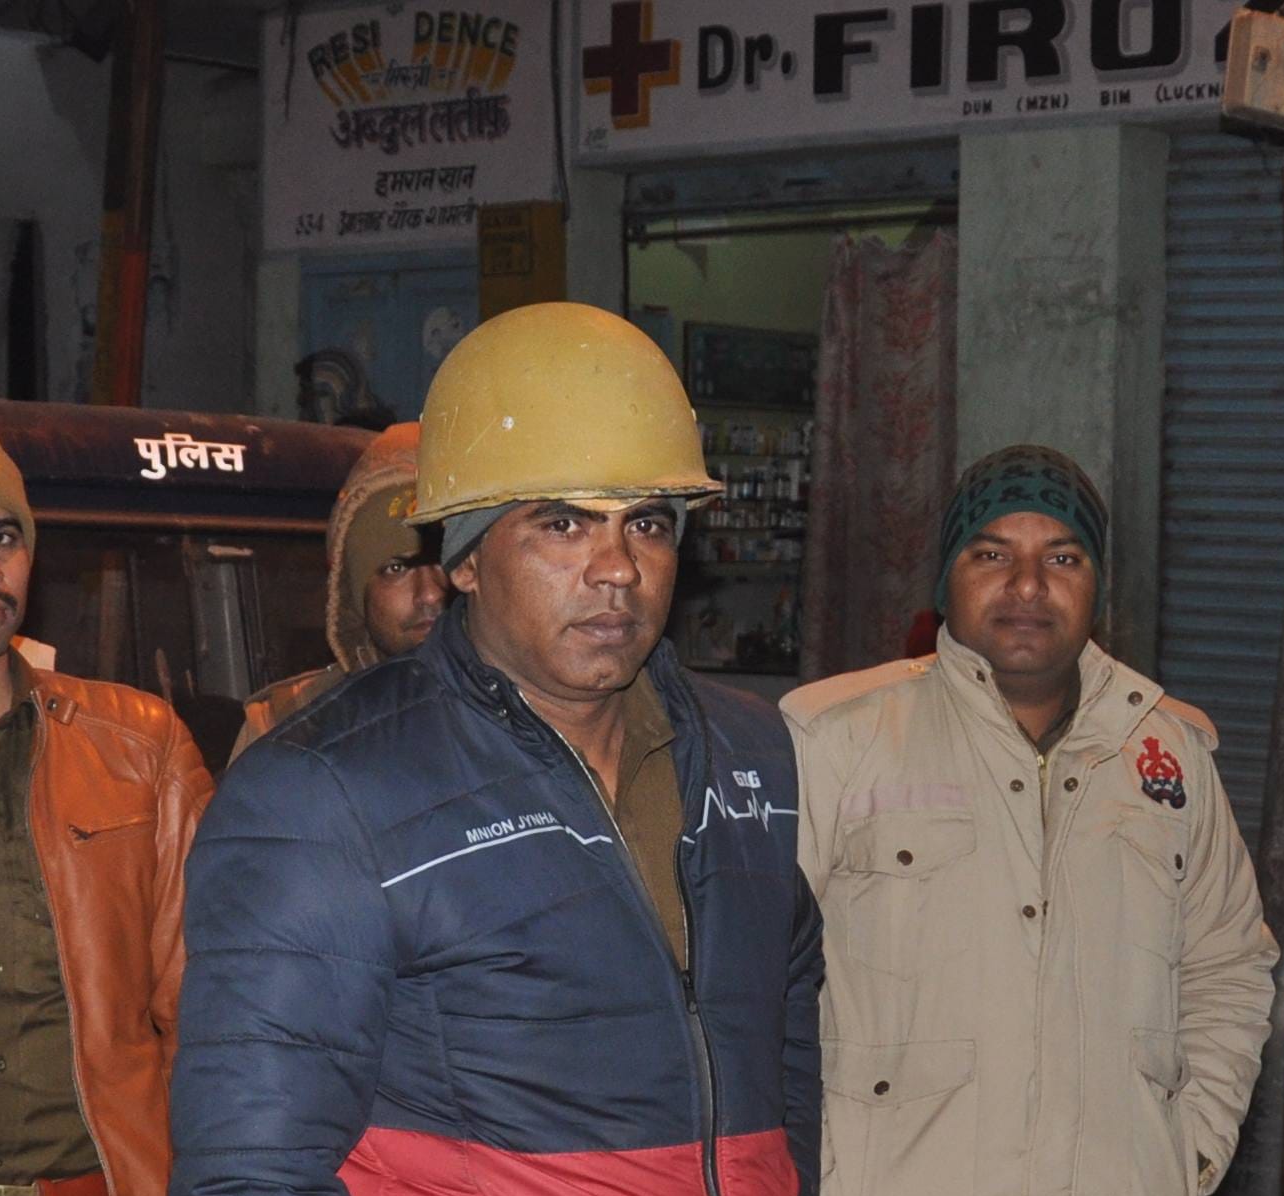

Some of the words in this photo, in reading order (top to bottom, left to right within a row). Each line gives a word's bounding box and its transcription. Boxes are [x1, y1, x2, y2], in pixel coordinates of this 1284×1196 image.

[698, 25, 793, 89] Dr.
[814, 0, 1284, 95] FIRO
[1155, 82, 1224, 104] (LUCKN
[133, 433, 247, 480] पुलिस
